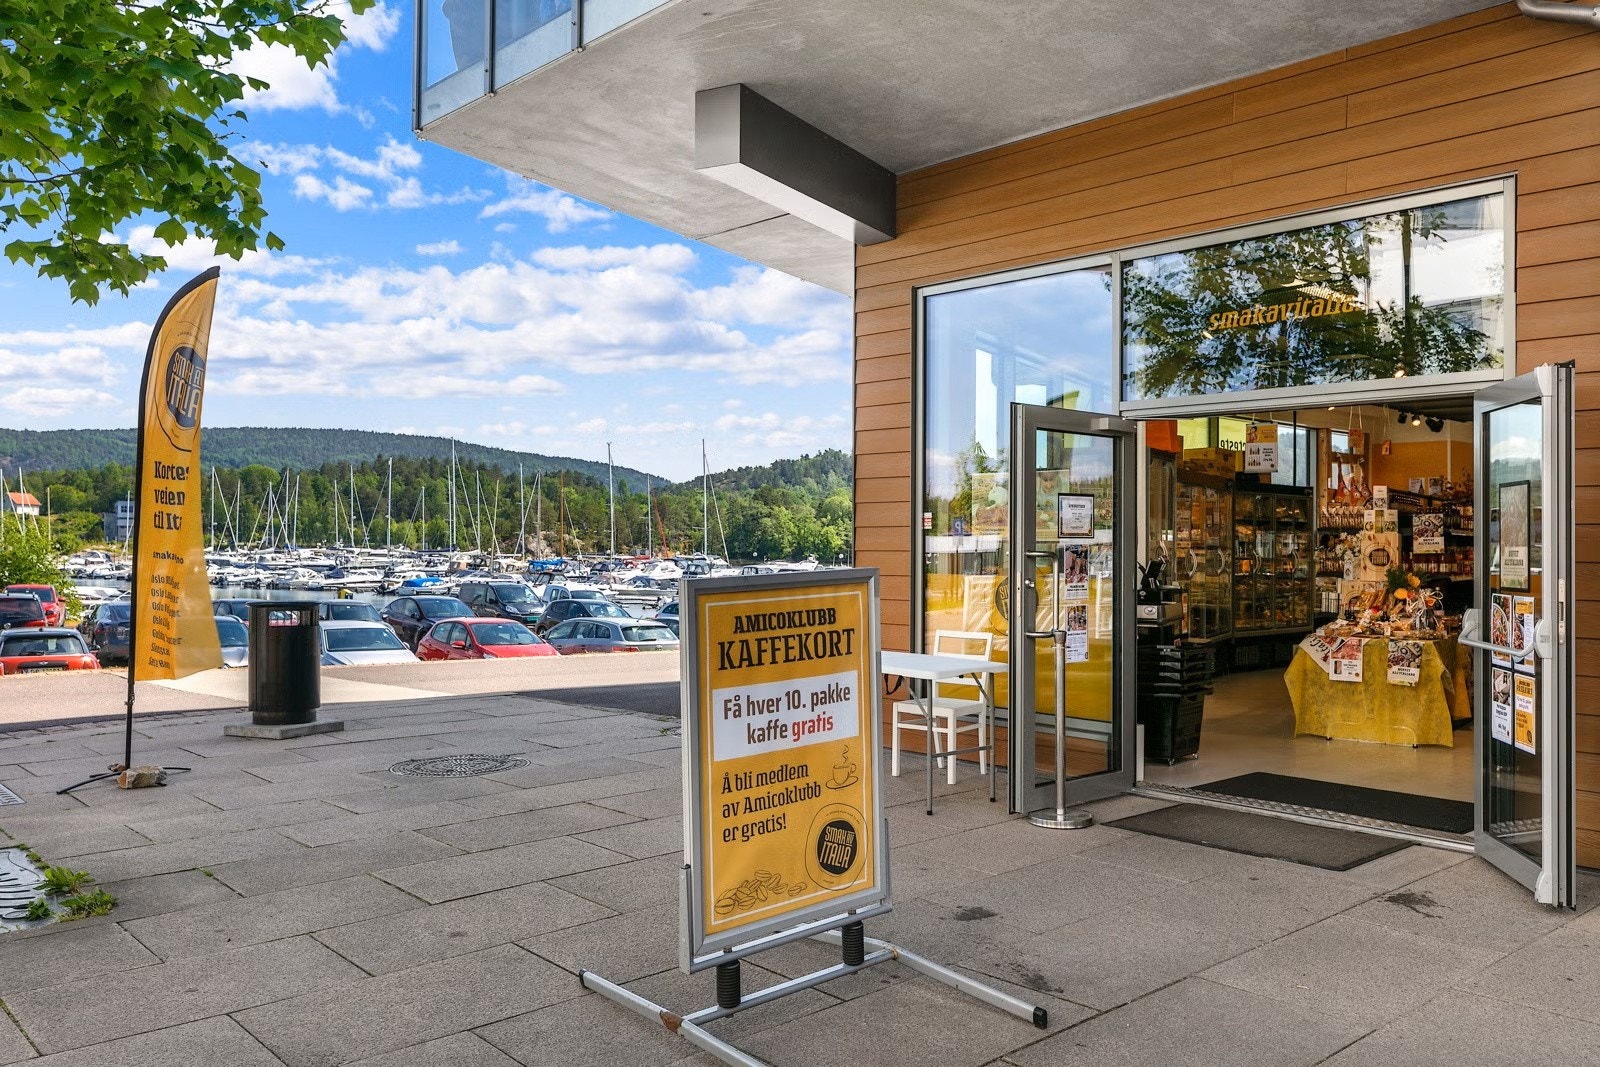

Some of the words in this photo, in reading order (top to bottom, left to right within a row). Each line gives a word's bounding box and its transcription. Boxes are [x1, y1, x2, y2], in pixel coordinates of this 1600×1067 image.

[167, 373, 201, 420] ITALIA
[154, 486, 185, 506] veien
[153, 510, 164, 529] til
[733, 608, 836, 634] AMICOKLUBB
[718, 628, 855, 671] KAFFEKORT
[723, 694, 742, 720] Få
[746, 694, 782, 717] hver
[785, 689, 806, 711] 10.
[811, 682, 851, 712] pakke
[747, 718, 788, 745] kaffe
[792, 711, 834, 743] gratis
[721, 771, 733, 795] Å
[735, 770, 752, 791] bli
[756, 763, 809, 787] medlem
[722, 801, 740, 818] av
[743, 781, 821, 815] Amicoklubb
[723, 826, 739, 843] er
[741, 812, 787, 842] gratis!
[824, 826, 847, 846] SMAK
[819, 841, 852, 869] ITALIA
